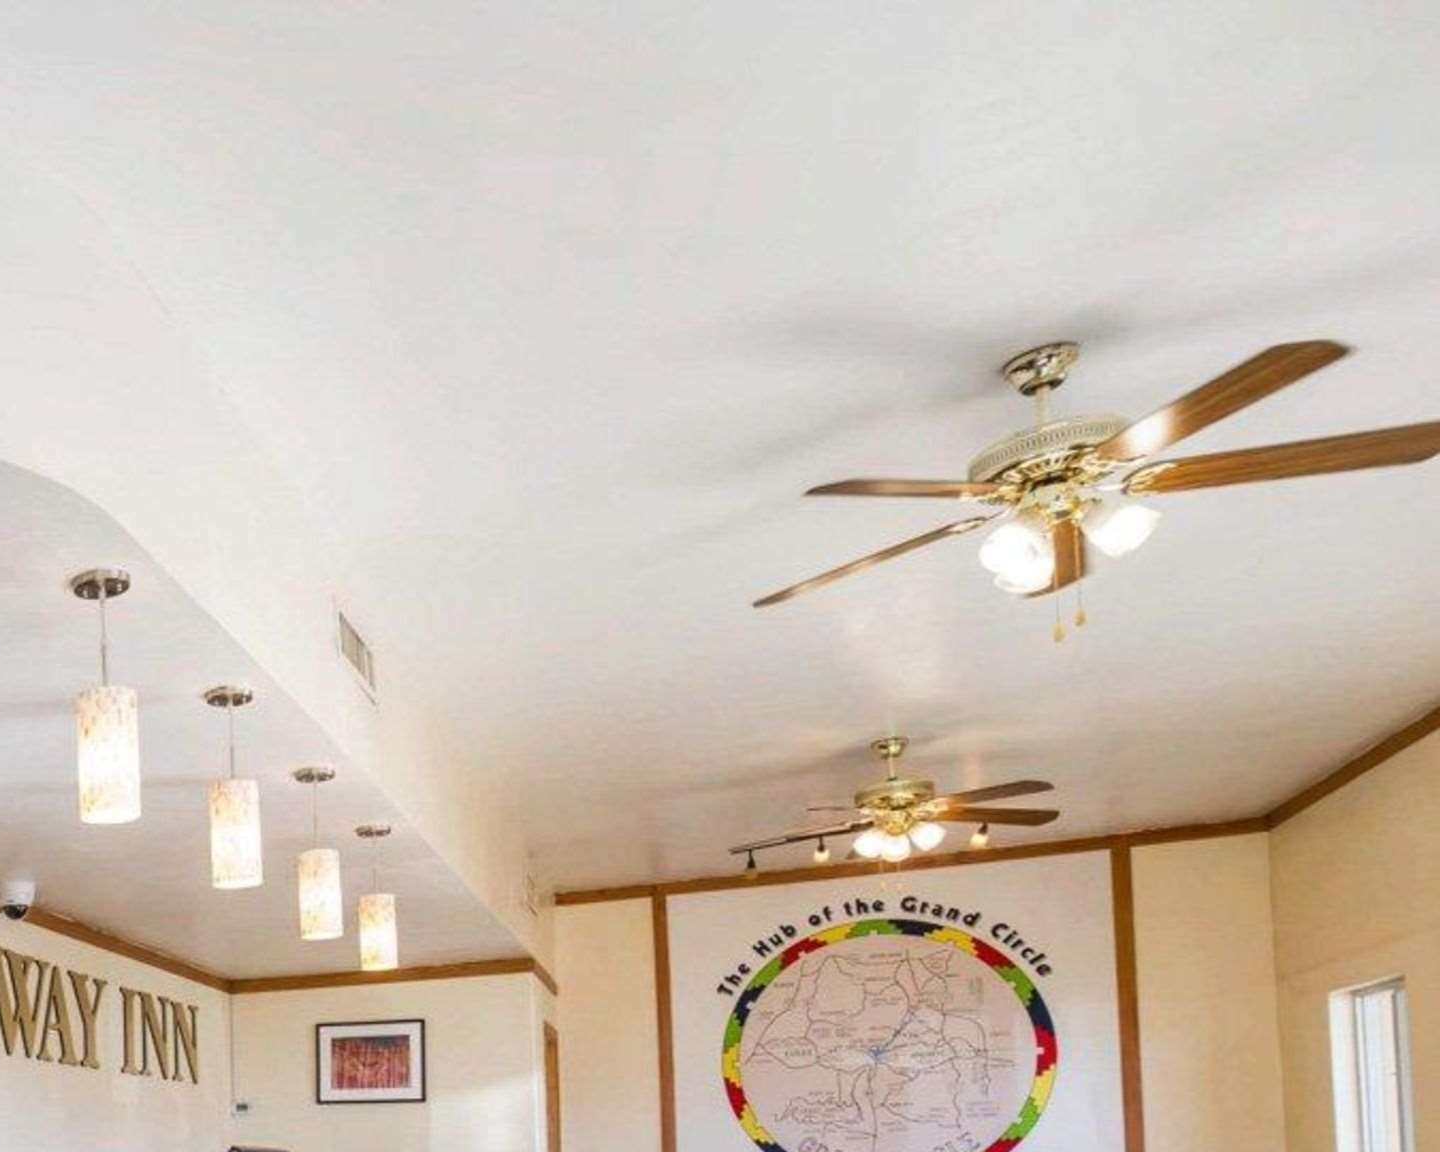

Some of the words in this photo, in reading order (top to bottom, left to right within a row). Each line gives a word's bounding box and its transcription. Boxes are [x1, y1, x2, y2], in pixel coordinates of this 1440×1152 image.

[716, 962, 751, 996] The
[752, 925, 797, 957] Hub
[808, 906, 832, 926] of
[843, 898, 885, 917] the
[900, 896, 982, 928] Grand
[991, 923, 1052, 977] Circle
[119, 986, 200, 1084] INN
